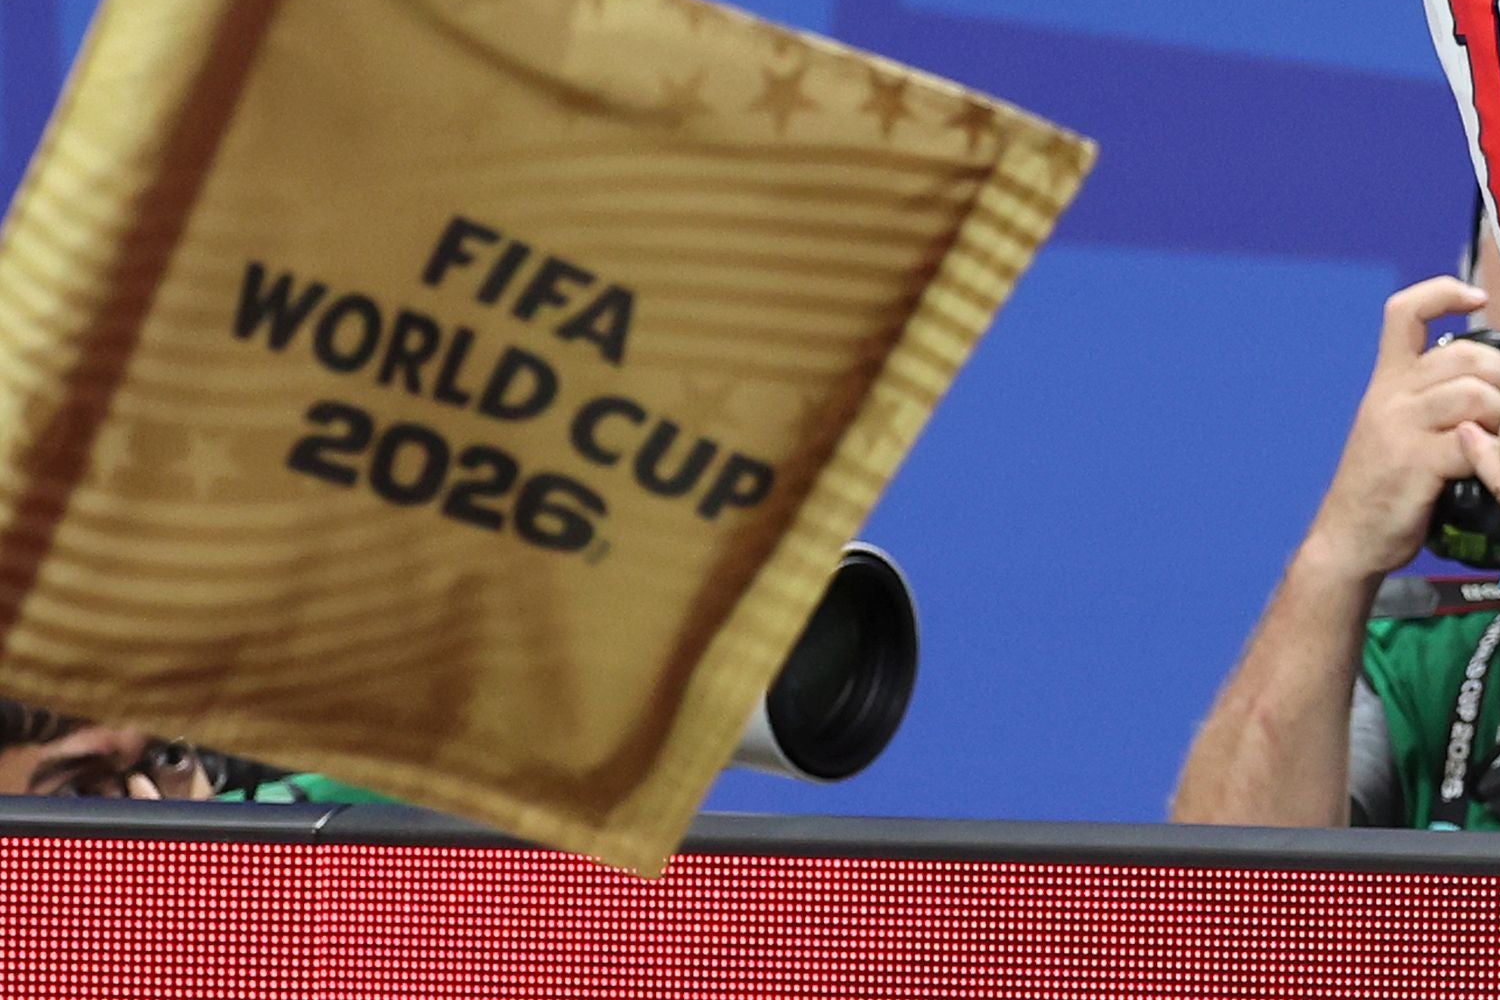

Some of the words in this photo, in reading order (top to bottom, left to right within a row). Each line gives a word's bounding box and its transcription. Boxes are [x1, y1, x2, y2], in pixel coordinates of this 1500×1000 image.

[419, 214, 638, 367] FIFA
[232, 261, 559, 423] WORLD
[569, 396, 776, 522] CUP
[286, 402, 608, 555] 2026
